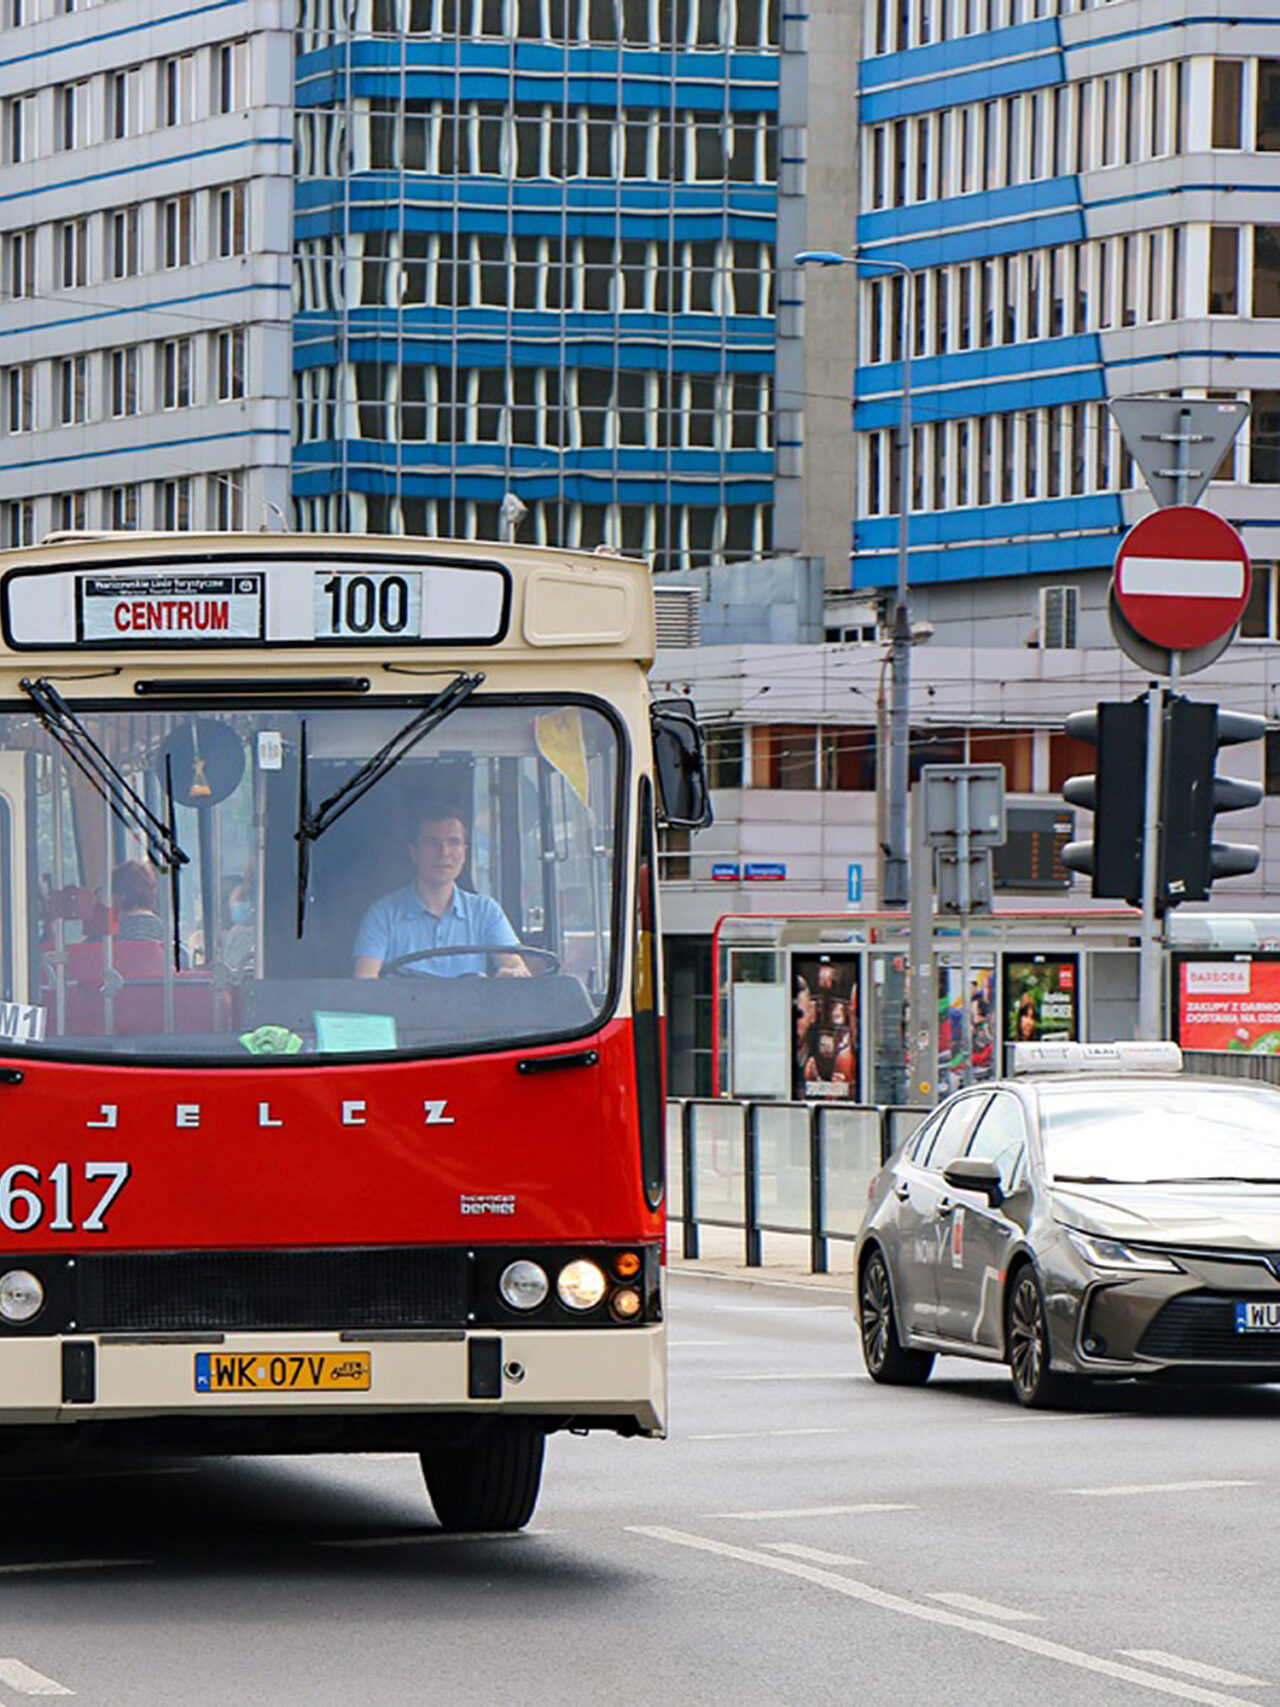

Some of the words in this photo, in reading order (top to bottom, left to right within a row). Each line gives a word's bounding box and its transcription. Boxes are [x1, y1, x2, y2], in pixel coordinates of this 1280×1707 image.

[114, 601, 229, 632] CENTRUM
[324, 576, 407, 634] 100
[1190, 972, 1245, 982] BARBORA
[1186, 1002, 1228, 1012] ZAKUPY
[1240, 1013, 1255, 1023] NA
[86, 1101, 455, 1128] JELCZ
[215, 1356, 256, 1386] WK
[270, 1356, 326, 1386] 07V
